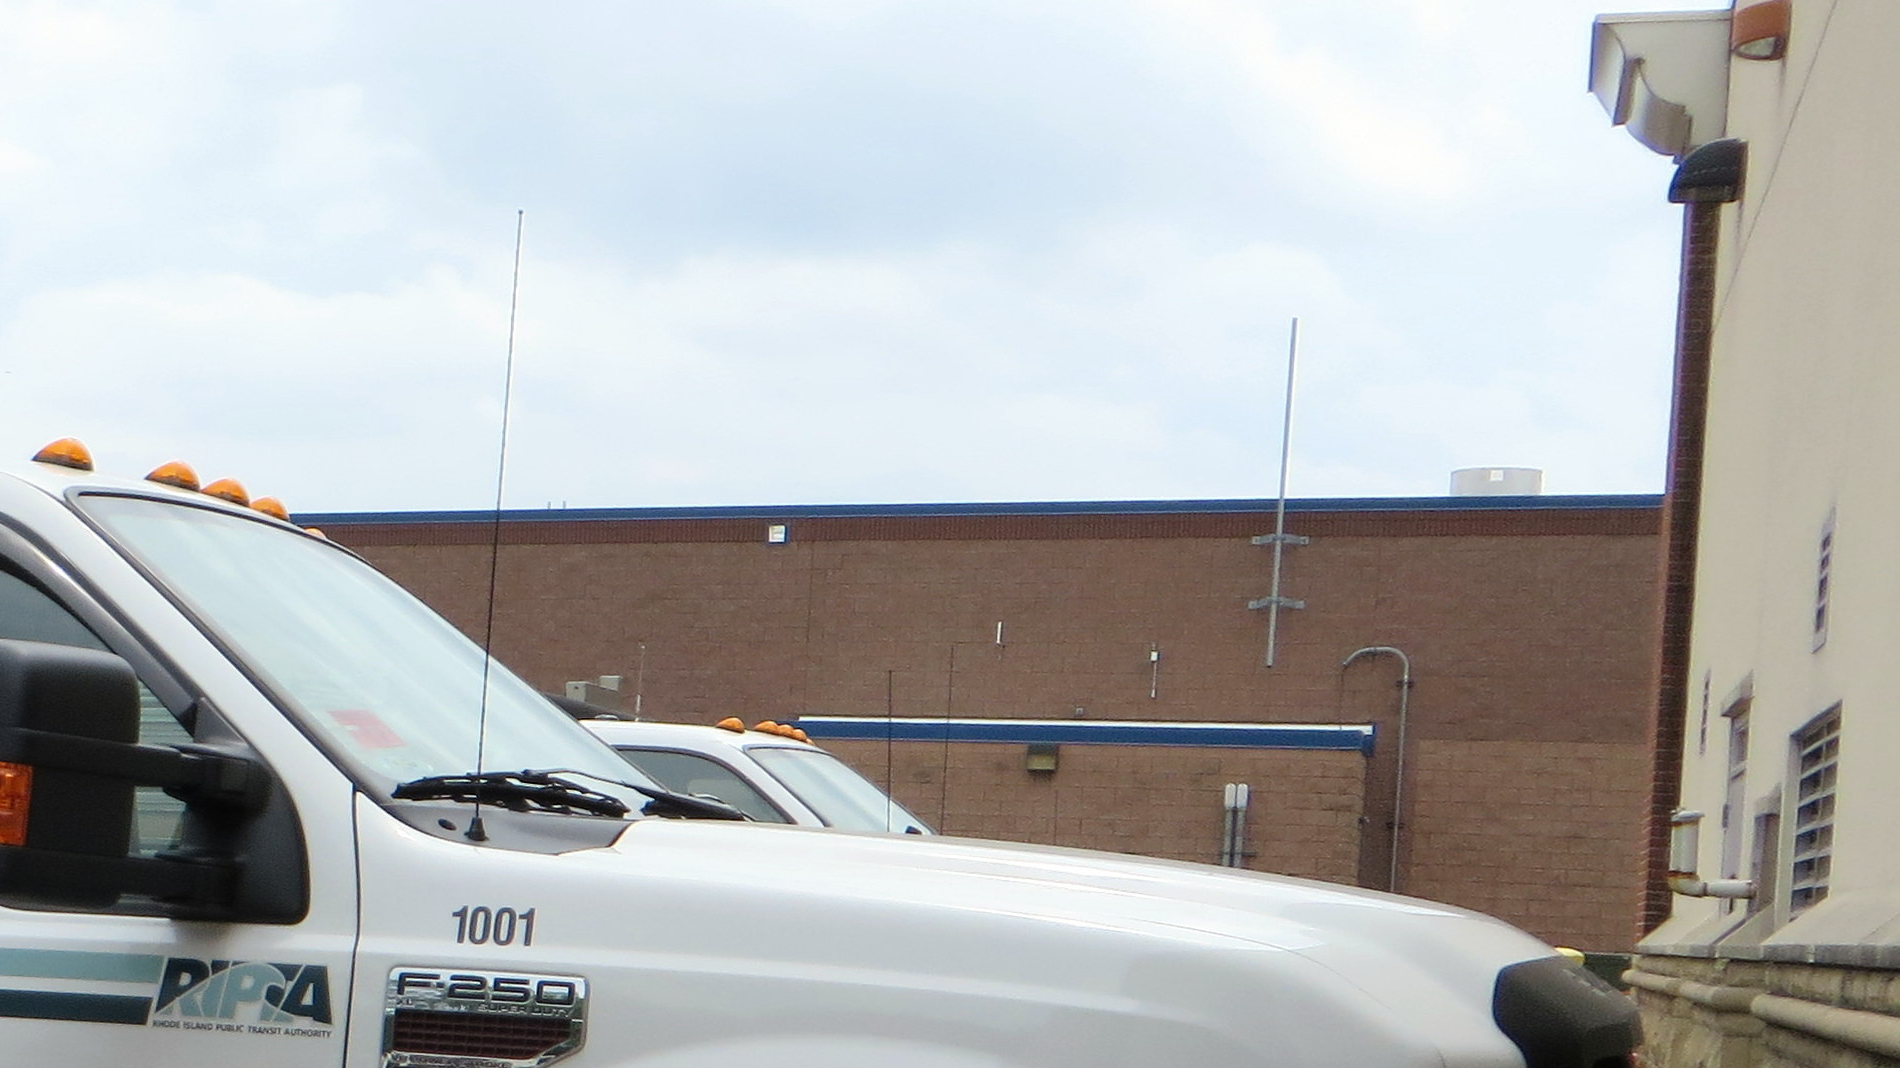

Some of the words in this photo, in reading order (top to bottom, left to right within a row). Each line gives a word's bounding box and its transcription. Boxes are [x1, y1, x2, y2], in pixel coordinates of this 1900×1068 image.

[452, 905, 535, 947] 1001
[155, 957, 332, 1025] RIPTA
[397, 972, 576, 1006] F-250
[478, 1003, 527, 1014] SUPER
[153, 1020, 180, 1029] RHODE
[183, 1021, 213, 1031] ISLAND
[216, 1023, 245, 1033] PUBLIC
[248, 1025, 282, 1036] TRANSIT
[284, 1027, 333, 1038] AUTHORITY
